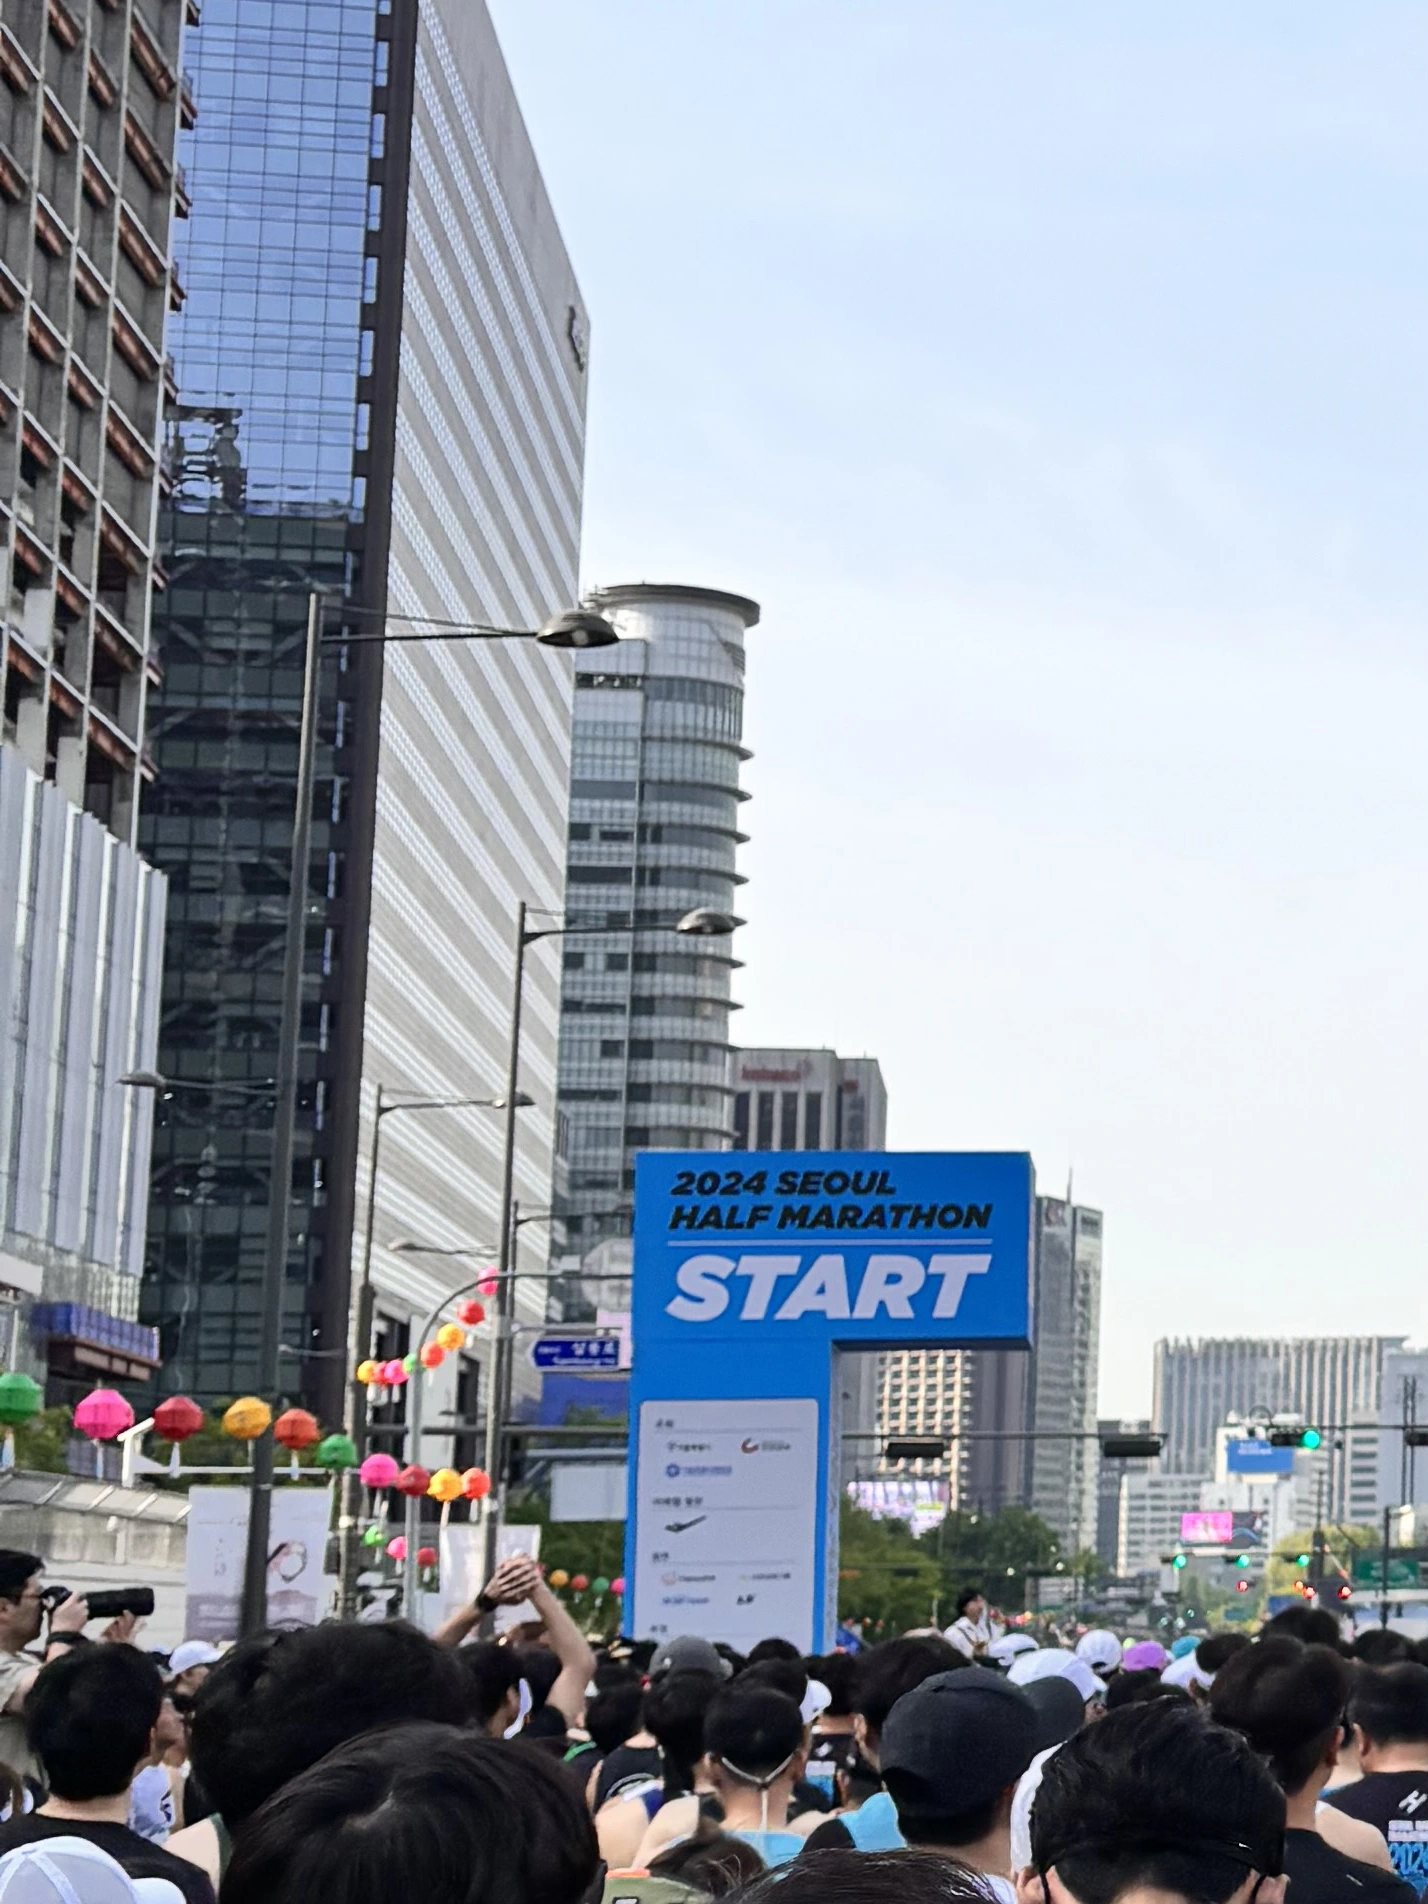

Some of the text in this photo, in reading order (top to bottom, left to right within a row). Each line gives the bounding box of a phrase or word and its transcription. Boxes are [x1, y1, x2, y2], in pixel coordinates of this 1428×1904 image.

[671, 1170, 896, 1196] 2024 SEOUL
[668, 1203, 993, 1230] HALF MARATHON
[664, 1253, 993, 1322] START
